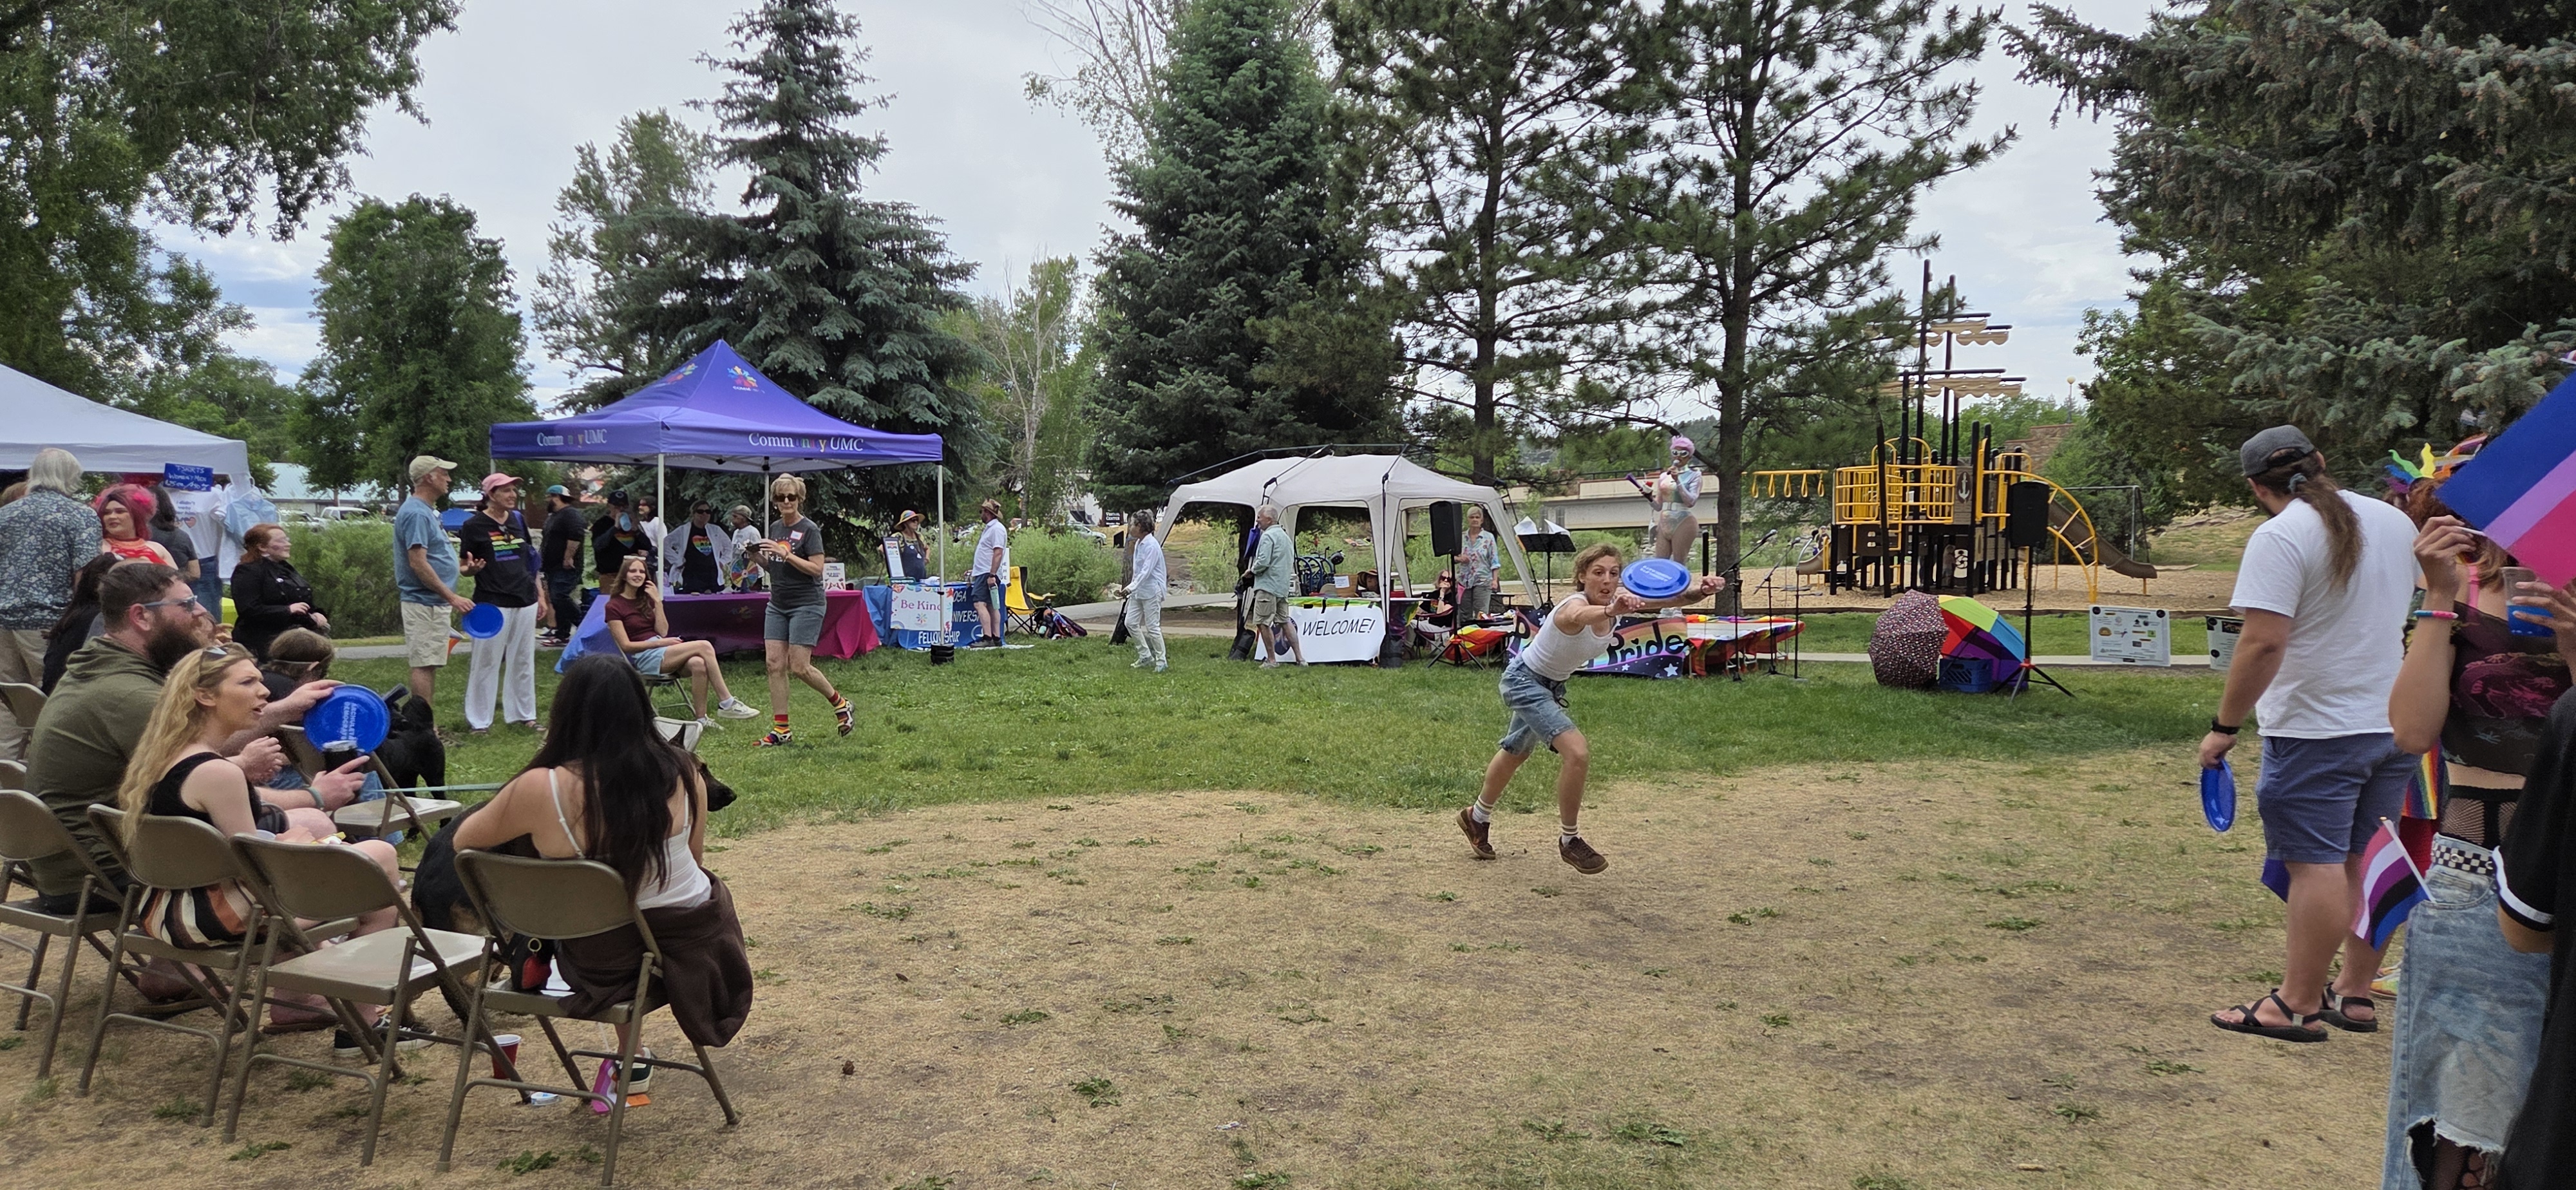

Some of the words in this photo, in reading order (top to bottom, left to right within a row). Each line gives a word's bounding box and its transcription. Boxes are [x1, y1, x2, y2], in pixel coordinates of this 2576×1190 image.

[537, 432, 584, 448] Commny
[584, 428, 607, 444] UMC
[830, 436, 864, 451] UMC
[901, 600, 914, 609] Be
[952, 590, 967, 603] OSA
[1303, 618, 1376, 636] WELCOME!
[1607, 621, 1690, 666] Pride
